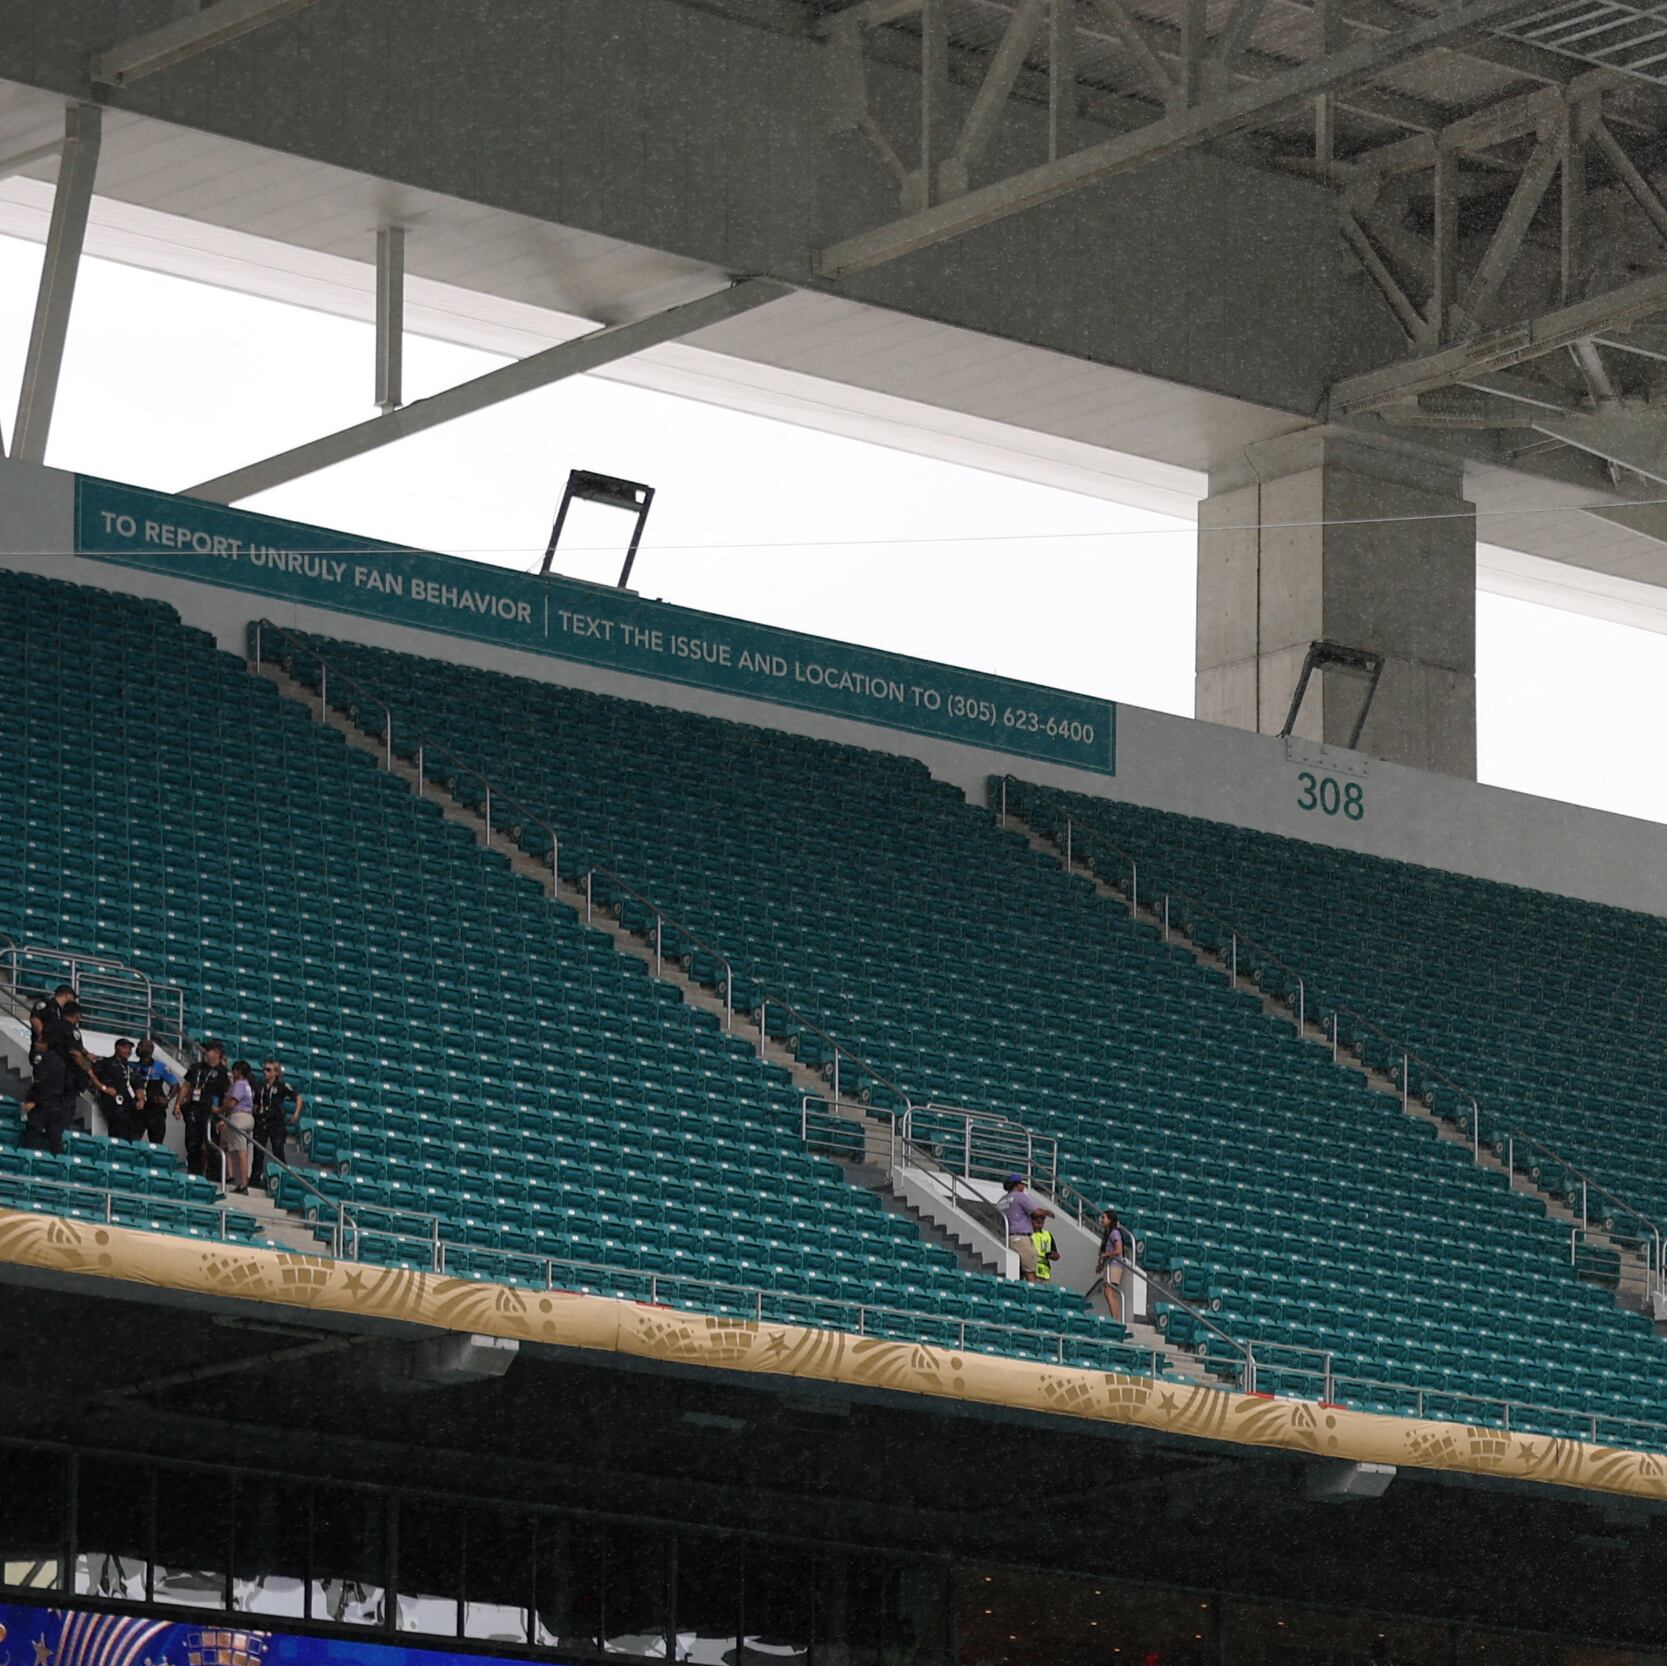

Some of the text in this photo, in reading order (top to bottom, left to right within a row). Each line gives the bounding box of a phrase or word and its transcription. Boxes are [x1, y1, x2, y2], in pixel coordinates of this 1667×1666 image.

[101, 511, 532, 624] TO REPORT UNRULY FAN BEHAVIOR
[558, 609, 1095, 745] TEXT THE ISSUE AND LOCATION TO (305) 623-6400
[1297, 772, 1364, 820] 308
